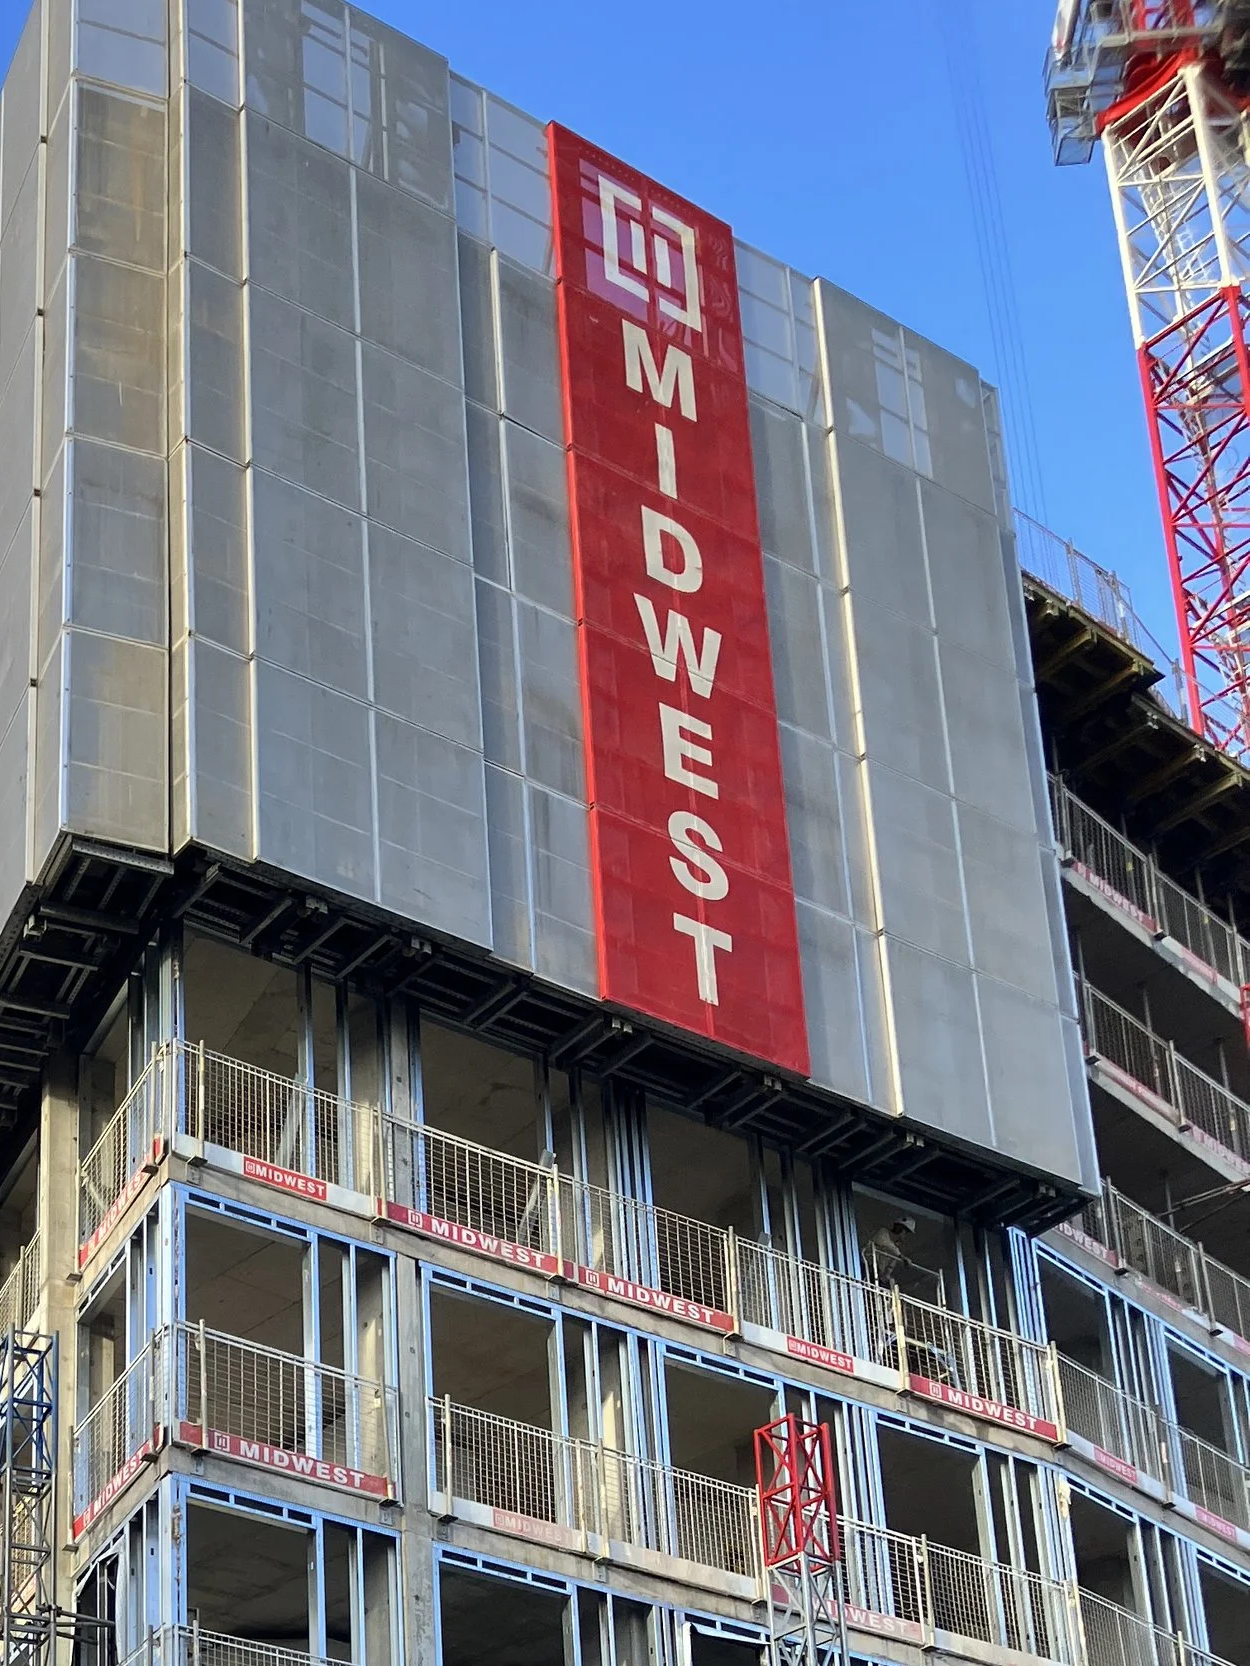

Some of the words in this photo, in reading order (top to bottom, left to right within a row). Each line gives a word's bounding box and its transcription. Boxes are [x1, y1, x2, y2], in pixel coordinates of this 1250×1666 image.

[622, 319, 733, 1006] MIDWEST
[256, 1164, 325, 1197] MIDWEST
[432, 1220, 545, 1268] MIDWEST
[1055, 1222, 1108, 1259] IDWEST
[608, 1277, 714, 1324] MIDWEST
[797, 1341, 853, 1369] MIDWEST
[949, 1388, 1037, 1430] MIDWEST
[93, 1449, 144, 1515] MIDWEST
[240, 1441, 365, 1488] MIDWEST
